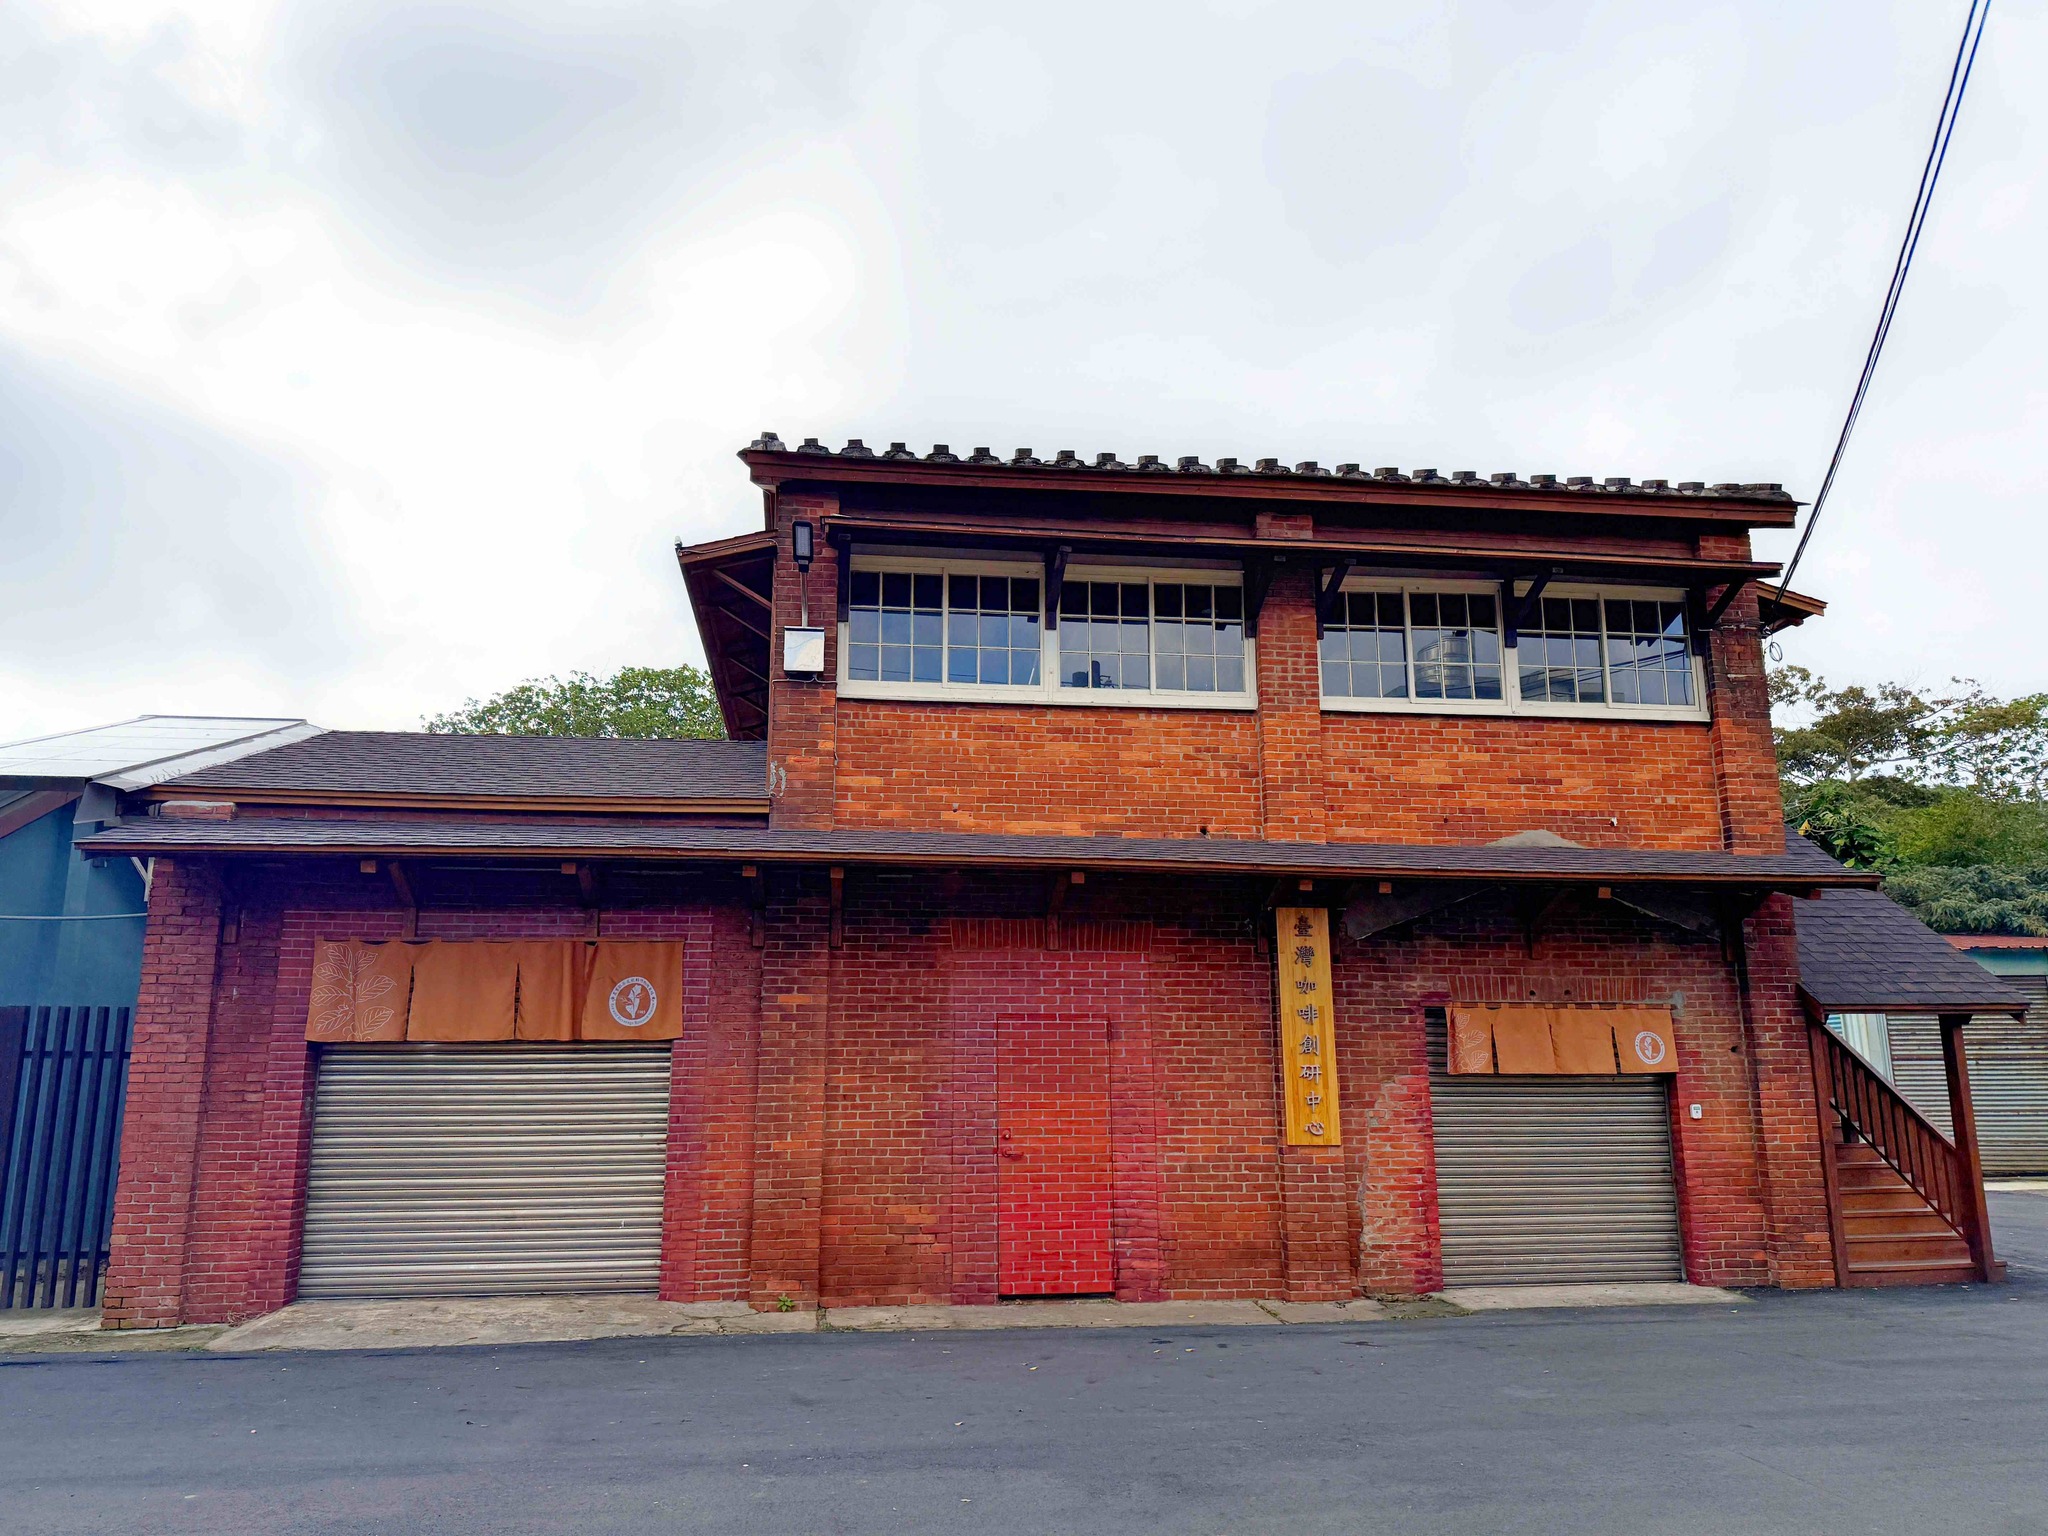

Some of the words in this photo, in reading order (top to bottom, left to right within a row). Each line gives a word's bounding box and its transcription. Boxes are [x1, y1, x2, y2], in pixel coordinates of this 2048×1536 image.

[1293, 914, 1325, 1136] 臺灣咖啡創研中心
